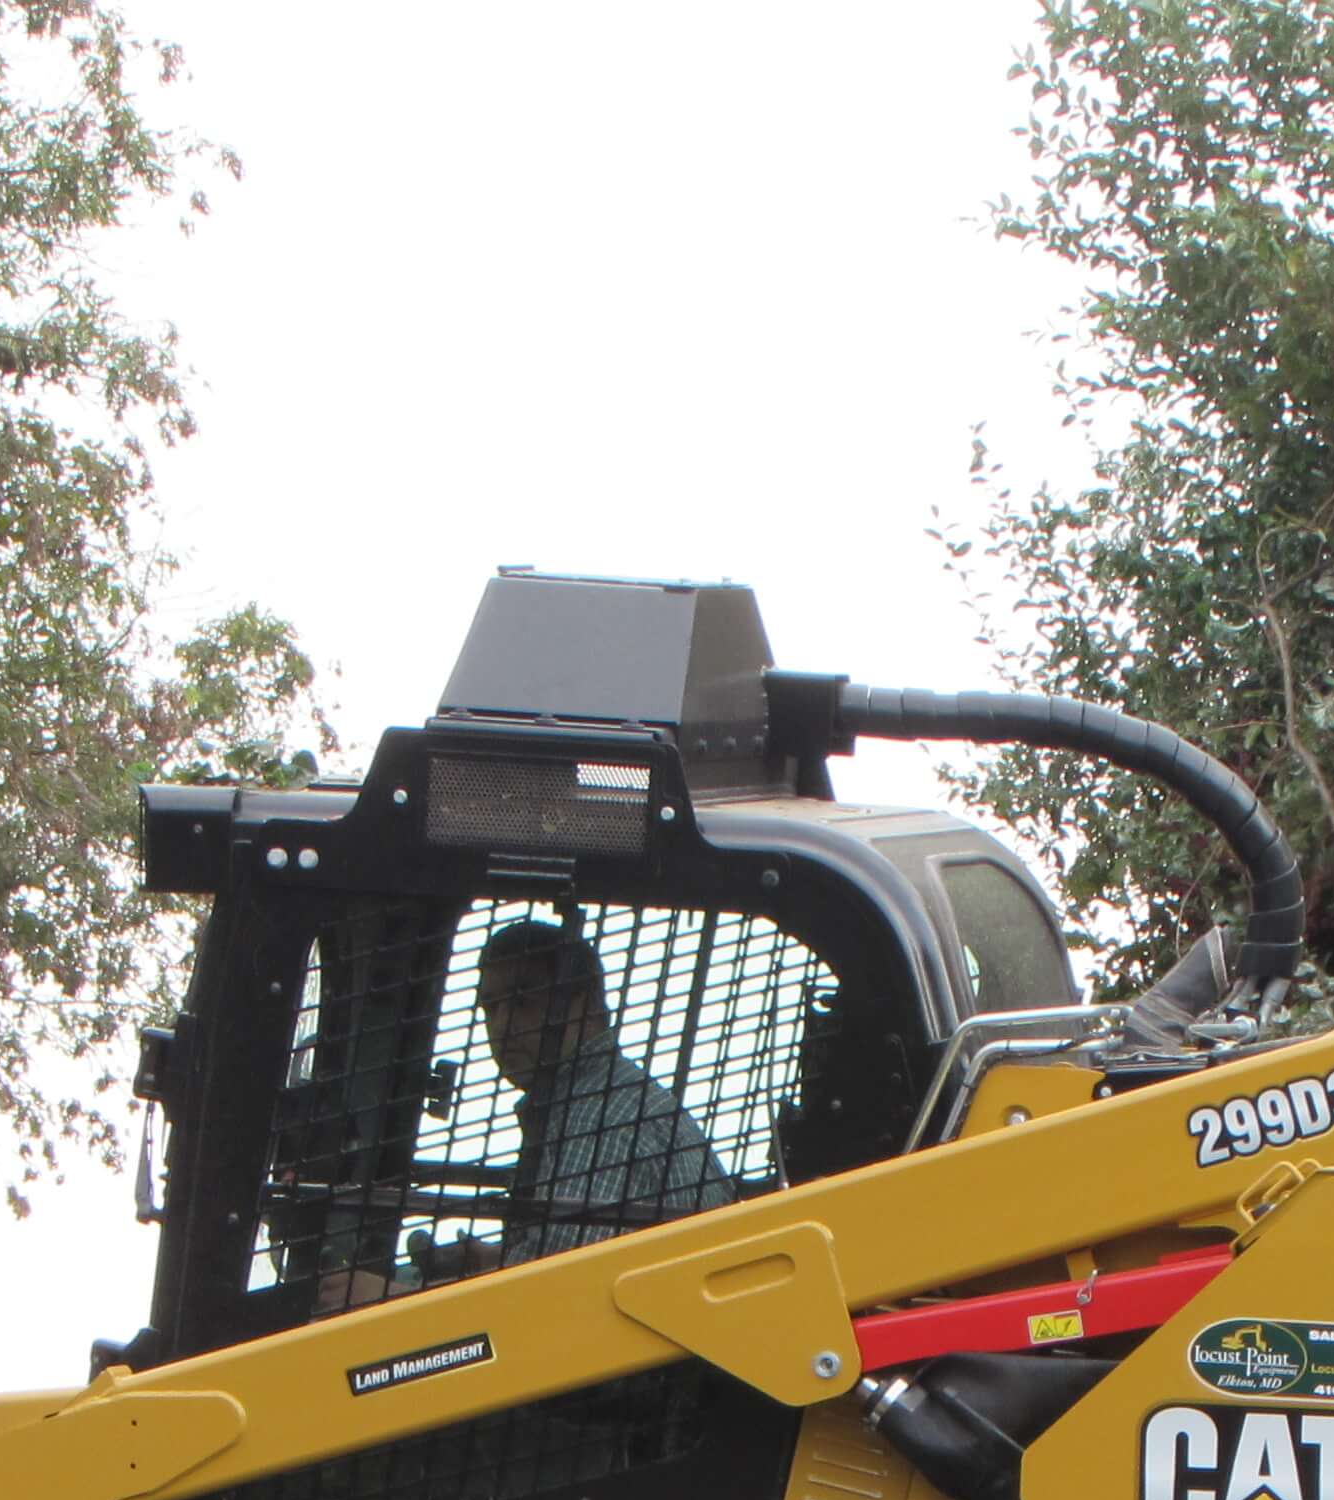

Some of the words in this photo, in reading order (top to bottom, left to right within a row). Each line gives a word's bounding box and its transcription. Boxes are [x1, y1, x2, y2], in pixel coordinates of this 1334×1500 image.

[356, 1369, 389, 1389] LAND
[393, 1342, 484, 1379] MANAGEMENT
[1247, 1347, 1290, 1376] Point
